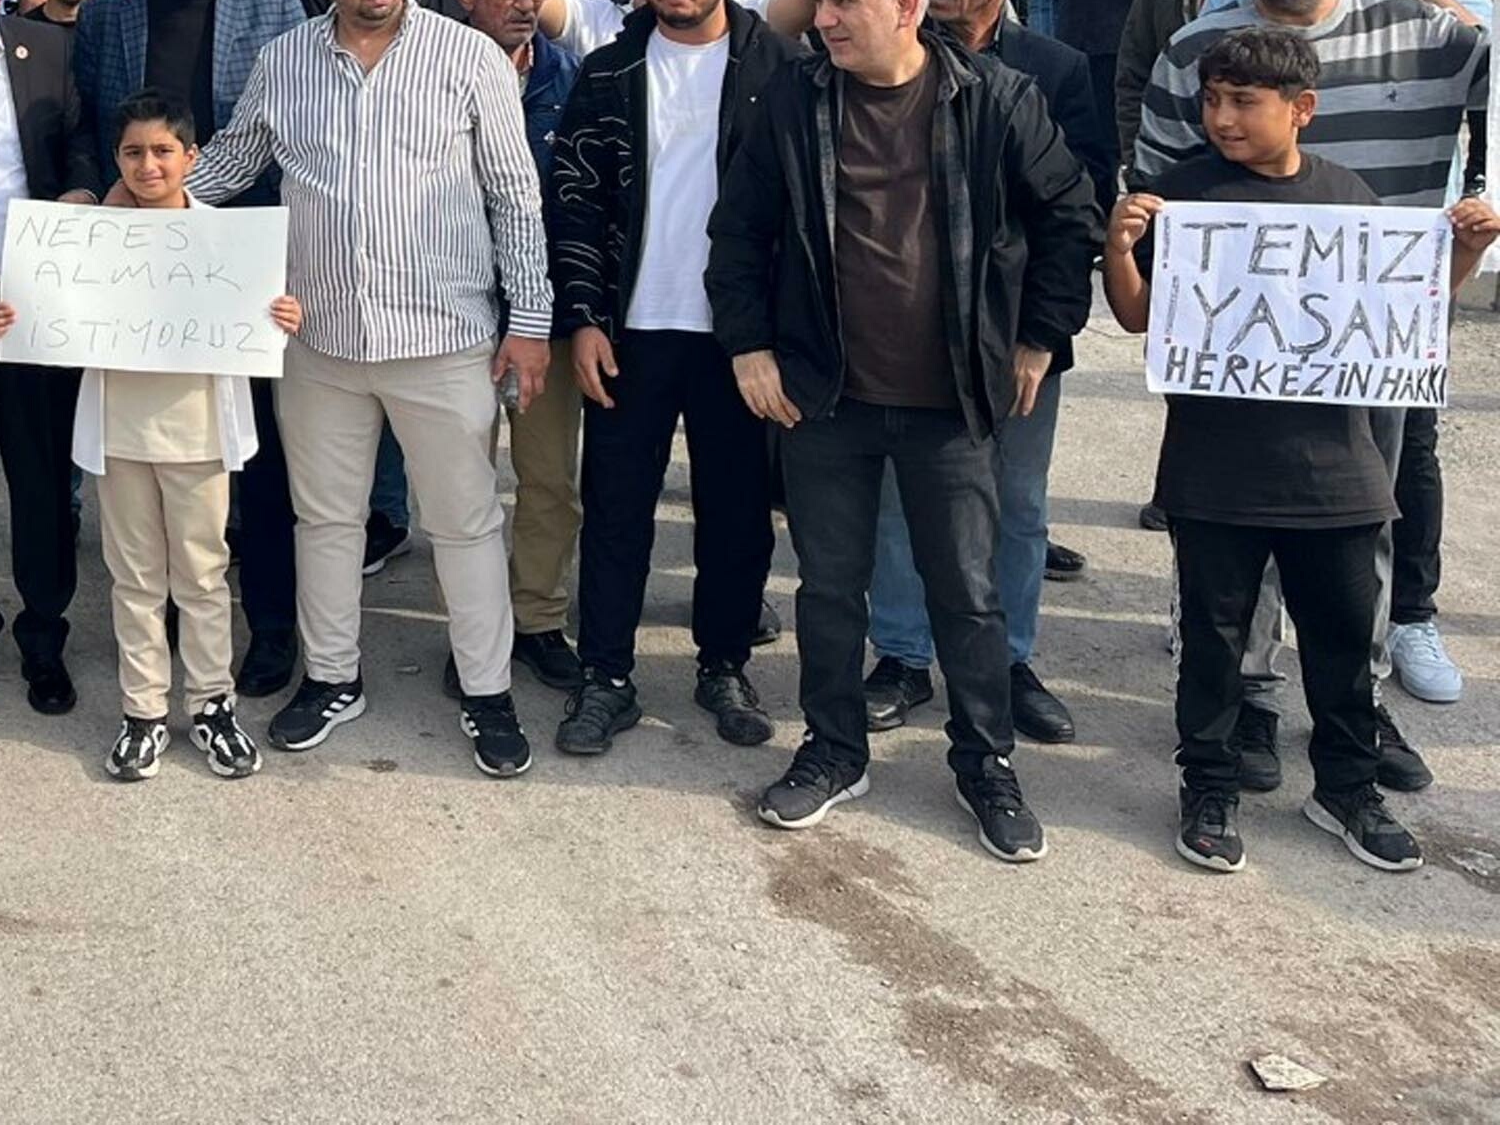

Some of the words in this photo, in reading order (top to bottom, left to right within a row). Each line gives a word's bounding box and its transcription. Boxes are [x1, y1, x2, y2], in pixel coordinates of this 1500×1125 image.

[16, 215, 190, 252] NEFES
[1181, 222, 1428, 283] TEMİZ
[34, 260, 243, 292] ALMAK
[30, 306, 268, 355] İSTİYORUZ
[1192, 283, 1421, 363] YAŞAM
[1164, 345, 1374, 398] HERKEZİN
[1373, 360, 1448, 406] HAKKI
